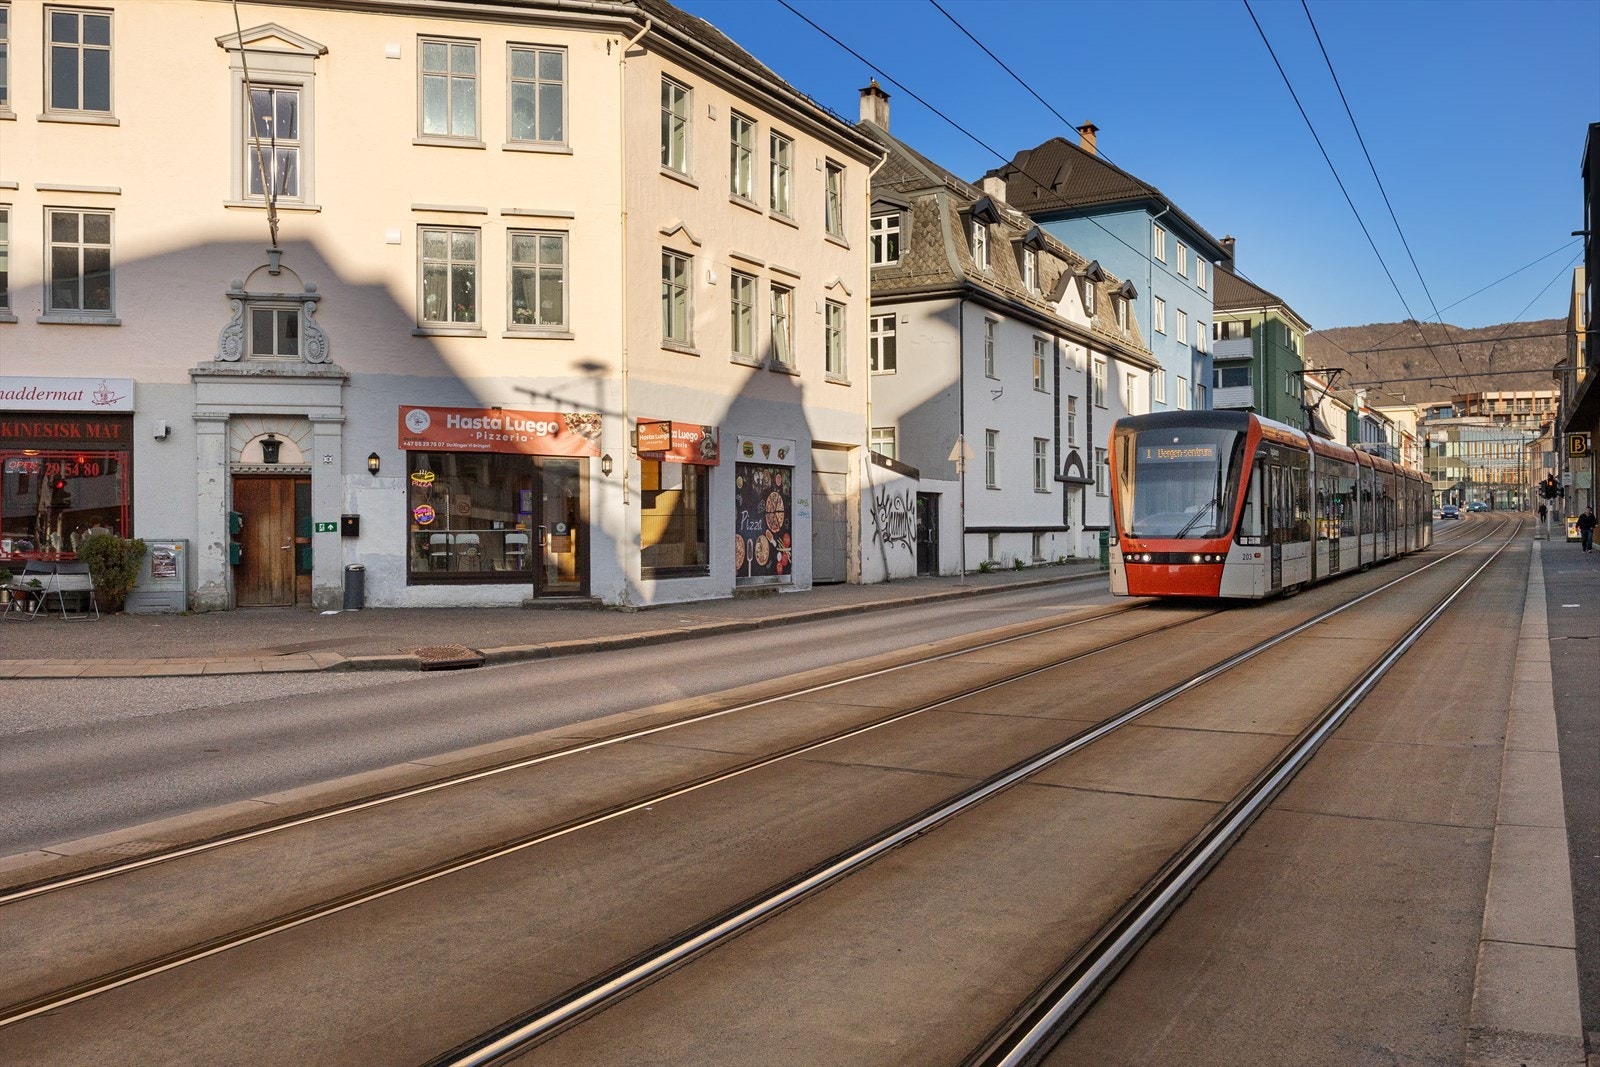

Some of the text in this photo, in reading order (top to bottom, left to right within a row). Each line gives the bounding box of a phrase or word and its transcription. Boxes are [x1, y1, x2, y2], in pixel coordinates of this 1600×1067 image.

[2, 422, 121, 439] KINESISK MAT
[446, 414, 502, 430] Hasta
[505, 416, 559, 436] Luego
[476, 431, 528, 443] Pizzeria
[678, 430, 699, 442] Luego
[1146, 448, 1152, 459] 1
[45, 462, 60, 476] 29
[64, 462, 80, 476] 54
[83, 462, 99, 476] 80
[411, 480, 433, 488] PIZZA
[740, 510, 763, 531] Pizza
[1242, 553, 1253, 561] 203
